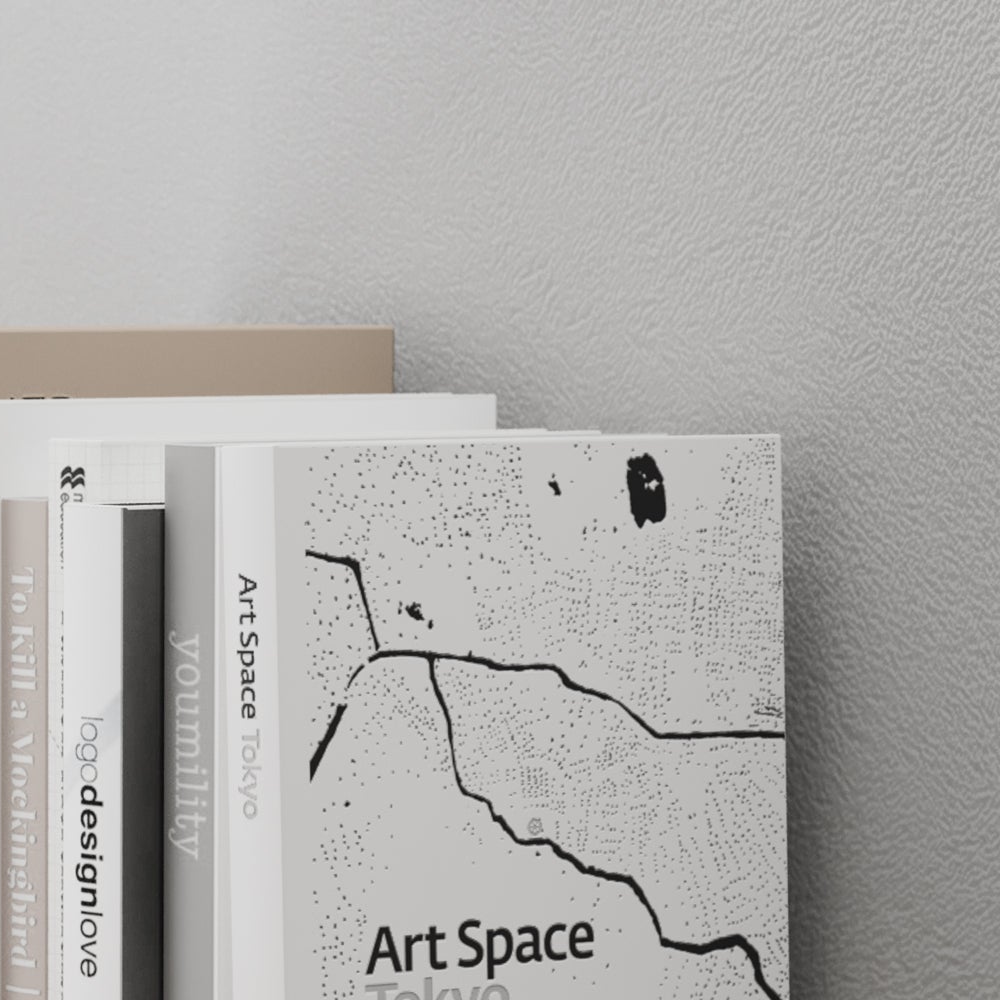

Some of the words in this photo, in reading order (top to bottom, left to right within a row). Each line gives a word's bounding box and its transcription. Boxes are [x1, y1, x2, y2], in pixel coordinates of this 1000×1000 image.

[11, 566, 35, 614] To
[238, 573, 257, 625] Art
[11, 625, 38, 691] Kill
[237, 631, 259, 720] Space
[10, 700, 29, 719] a
[168, 630, 209, 861] youmility
[238, 728, 262, 821] Tokyo
[7, 732, 38, 969] Mockingbird
[75, 715, 104, 978] logodesignlove
[365, 925, 448, 975] Art
[457, 918, 595, 980] Space
